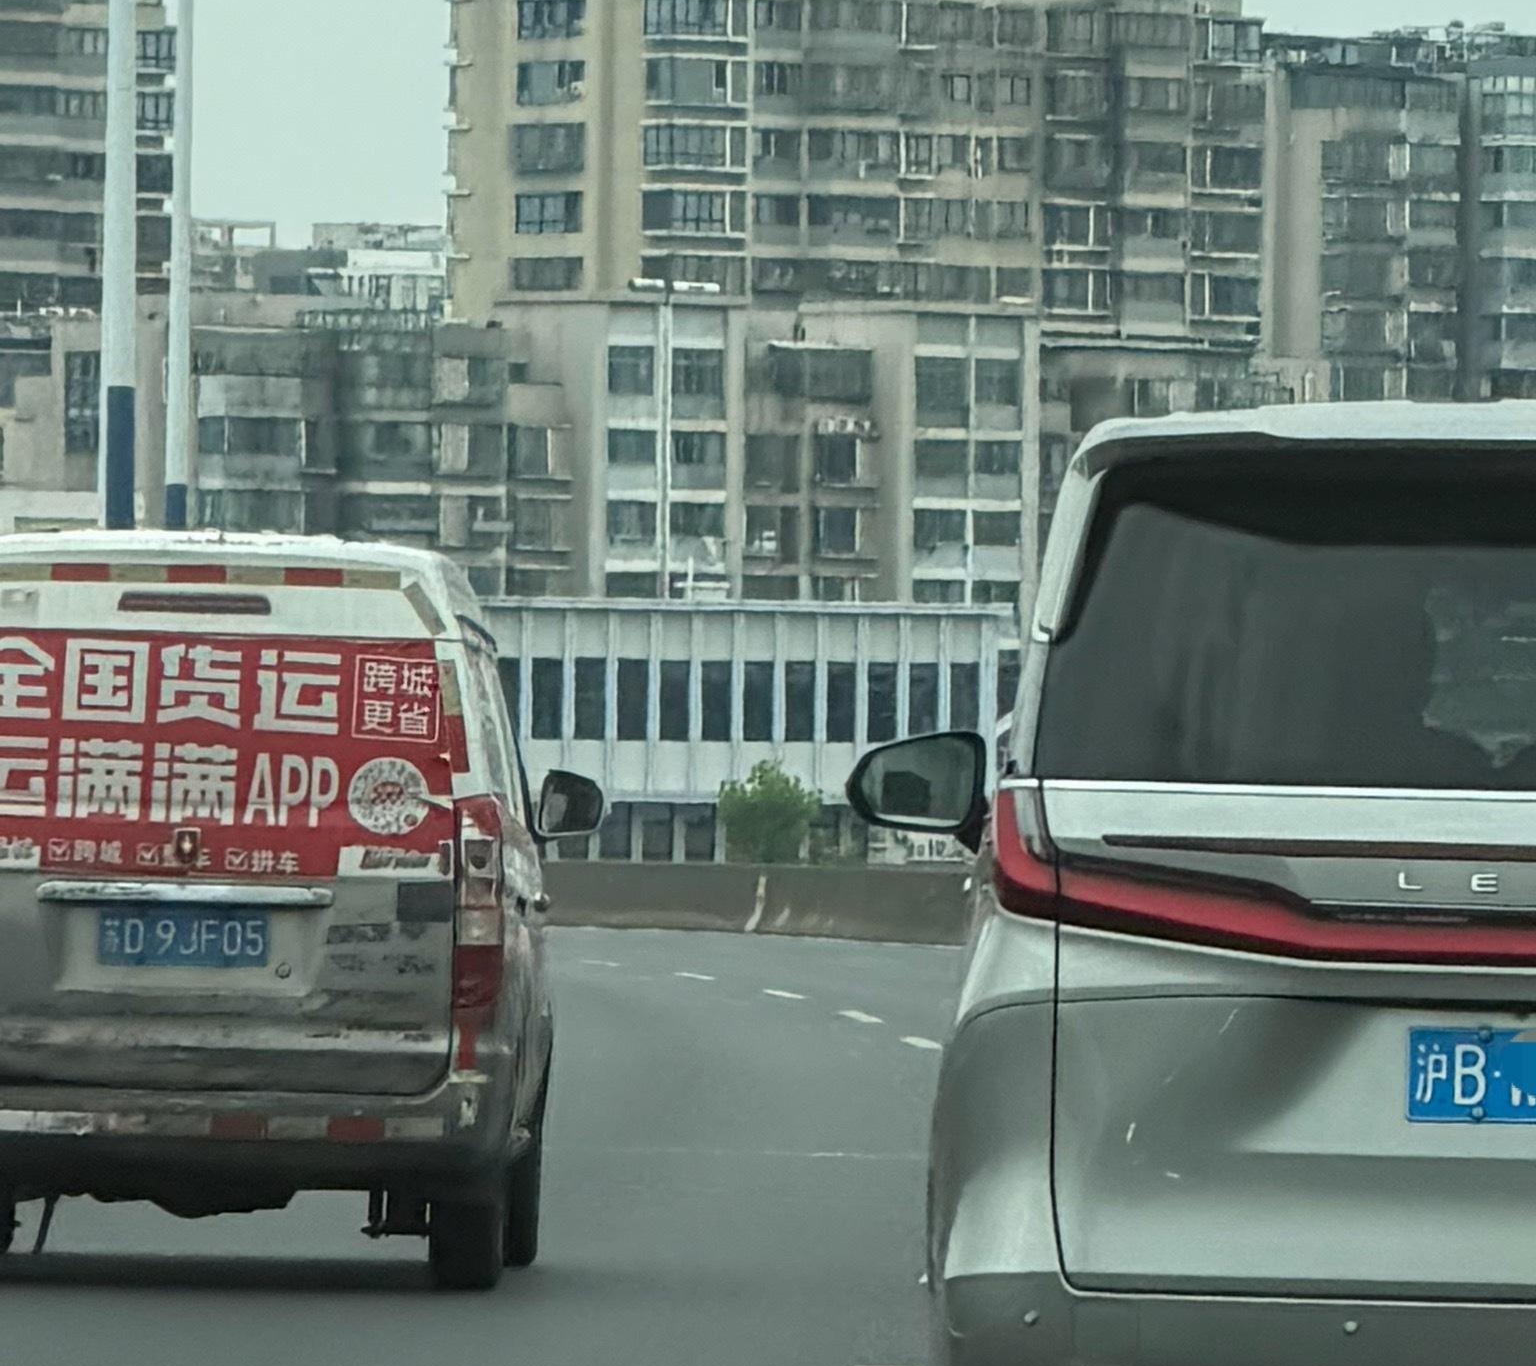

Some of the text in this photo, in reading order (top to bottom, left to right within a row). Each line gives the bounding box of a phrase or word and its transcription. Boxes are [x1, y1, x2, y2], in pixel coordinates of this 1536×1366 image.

[0, 636, 341, 734] 全国货运
[364, 662, 433, 697] 跨城
[362, 700, 430, 735] 更省
